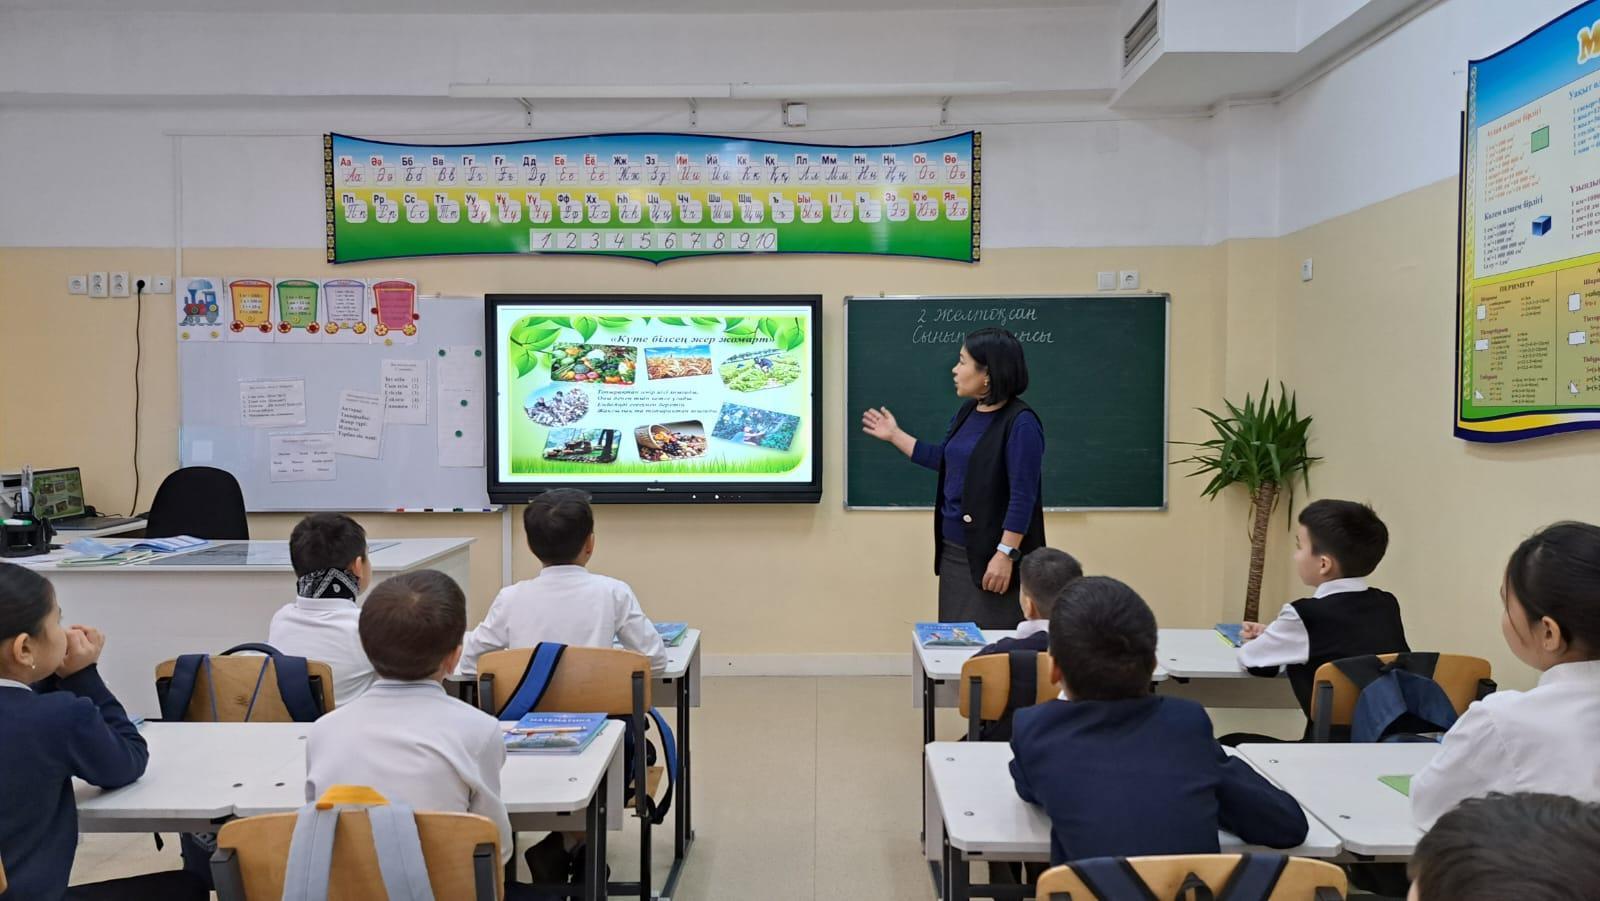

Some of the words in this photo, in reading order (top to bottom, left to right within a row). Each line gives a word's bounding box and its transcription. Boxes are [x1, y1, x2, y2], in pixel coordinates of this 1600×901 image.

[340, 158, 352, 166] Аа
[402, 157, 414, 166] Бб
[432, 157, 444, 166] Вв
[462, 157, 473, 165] Гг
[522, 157, 536, 166] Дд
[554, 156, 564, 165] Ее
[613, 157, 627, 165] Жж
[646, 156, 656, 165] Зз
[676, 156, 688, 165] Ии
[737, 156, 747, 165] Кк
[796, 156, 808, 165] Лл
[914, 155, 926, 164] Оо
[944, 155, 956, 163] Өө
[342, 195, 354, 203] Пп
[373, 195, 385, 204] Рр
[404, 195, 415, 203] Сс
[435, 195, 444, 203] Тт
[557, 194, 570, 204] Фф
[586, 195, 597, 204] Хх
[648, 195, 659, 204] Цц
[678, 195, 689, 203] Чч
[708, 194, 721, 202] Шш
[738, 194, 752, 204] Щщ
[797, 195, 811, 203] Ыы
[542, 232, 552, 249] 1
[566, 232, 577, 249] 2
[590, 232, 600, 249] 3
[614, 232, 624, 249] 4
[639, 232, 651, 249] 5
[664, 232, 676, 249] 6
[690, 232, 701, 249] 7
[713, 232, 726, 249] 8
[738, 232, 750, 249] 9
[755, 232, 776, 249] 10
[918, 309, 926, 323] 2
